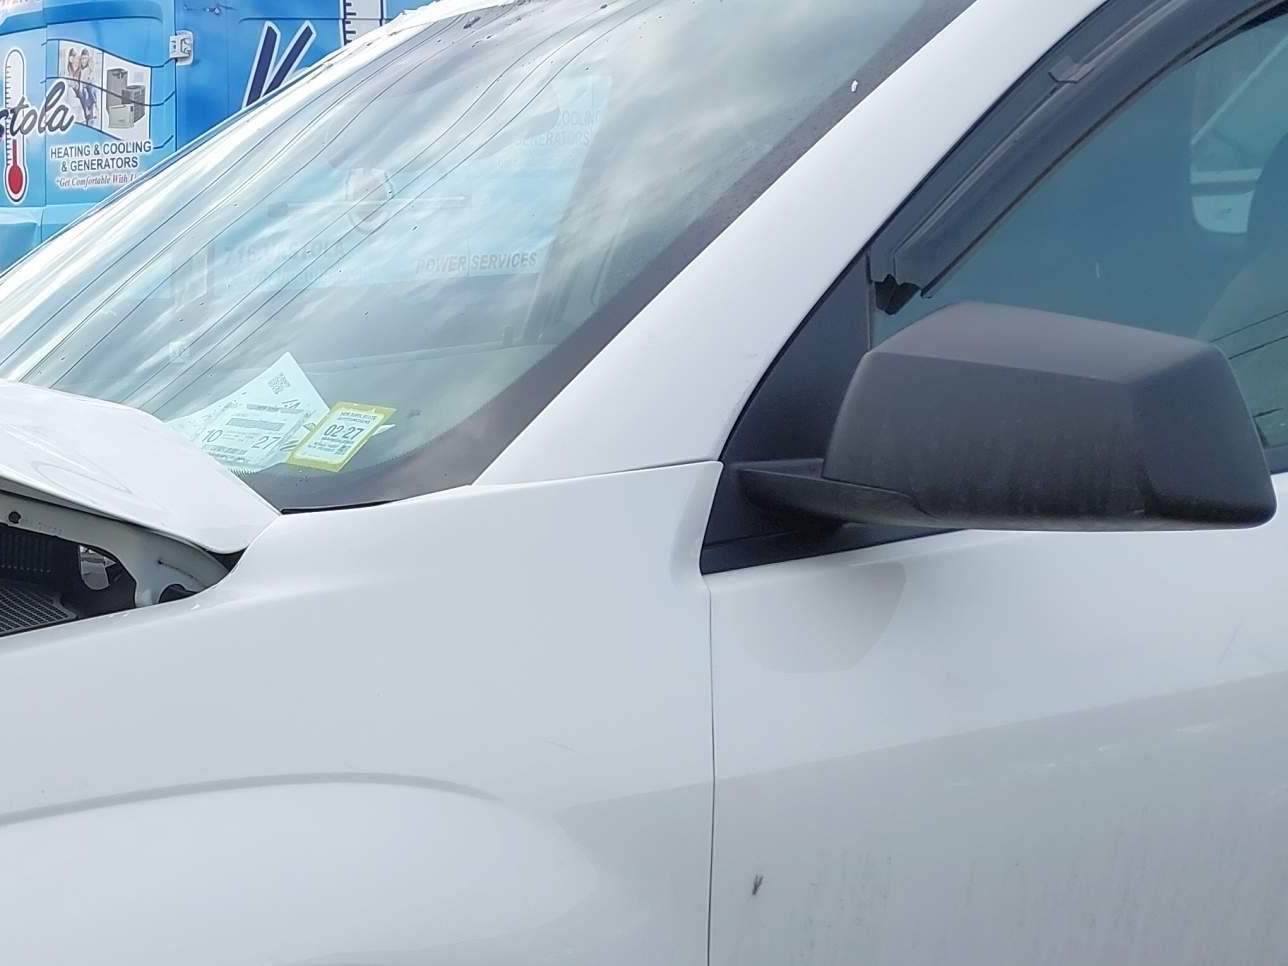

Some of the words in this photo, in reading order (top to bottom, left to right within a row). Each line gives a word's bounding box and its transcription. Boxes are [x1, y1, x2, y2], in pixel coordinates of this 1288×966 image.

[50, 145, 91, 159] HEATING
[93, 143, 101, 155] &
[103, 140, 152, 155] COOLING
[61, 160, 68, 172] &
[70, 156, 139, 172] GENERATORS
[416, 255, 468, 274] POWER
[471, 251, 538, 270] SERVICES
[202, 429, 224, 443] 10
[251, 435, 282, 450] 27
